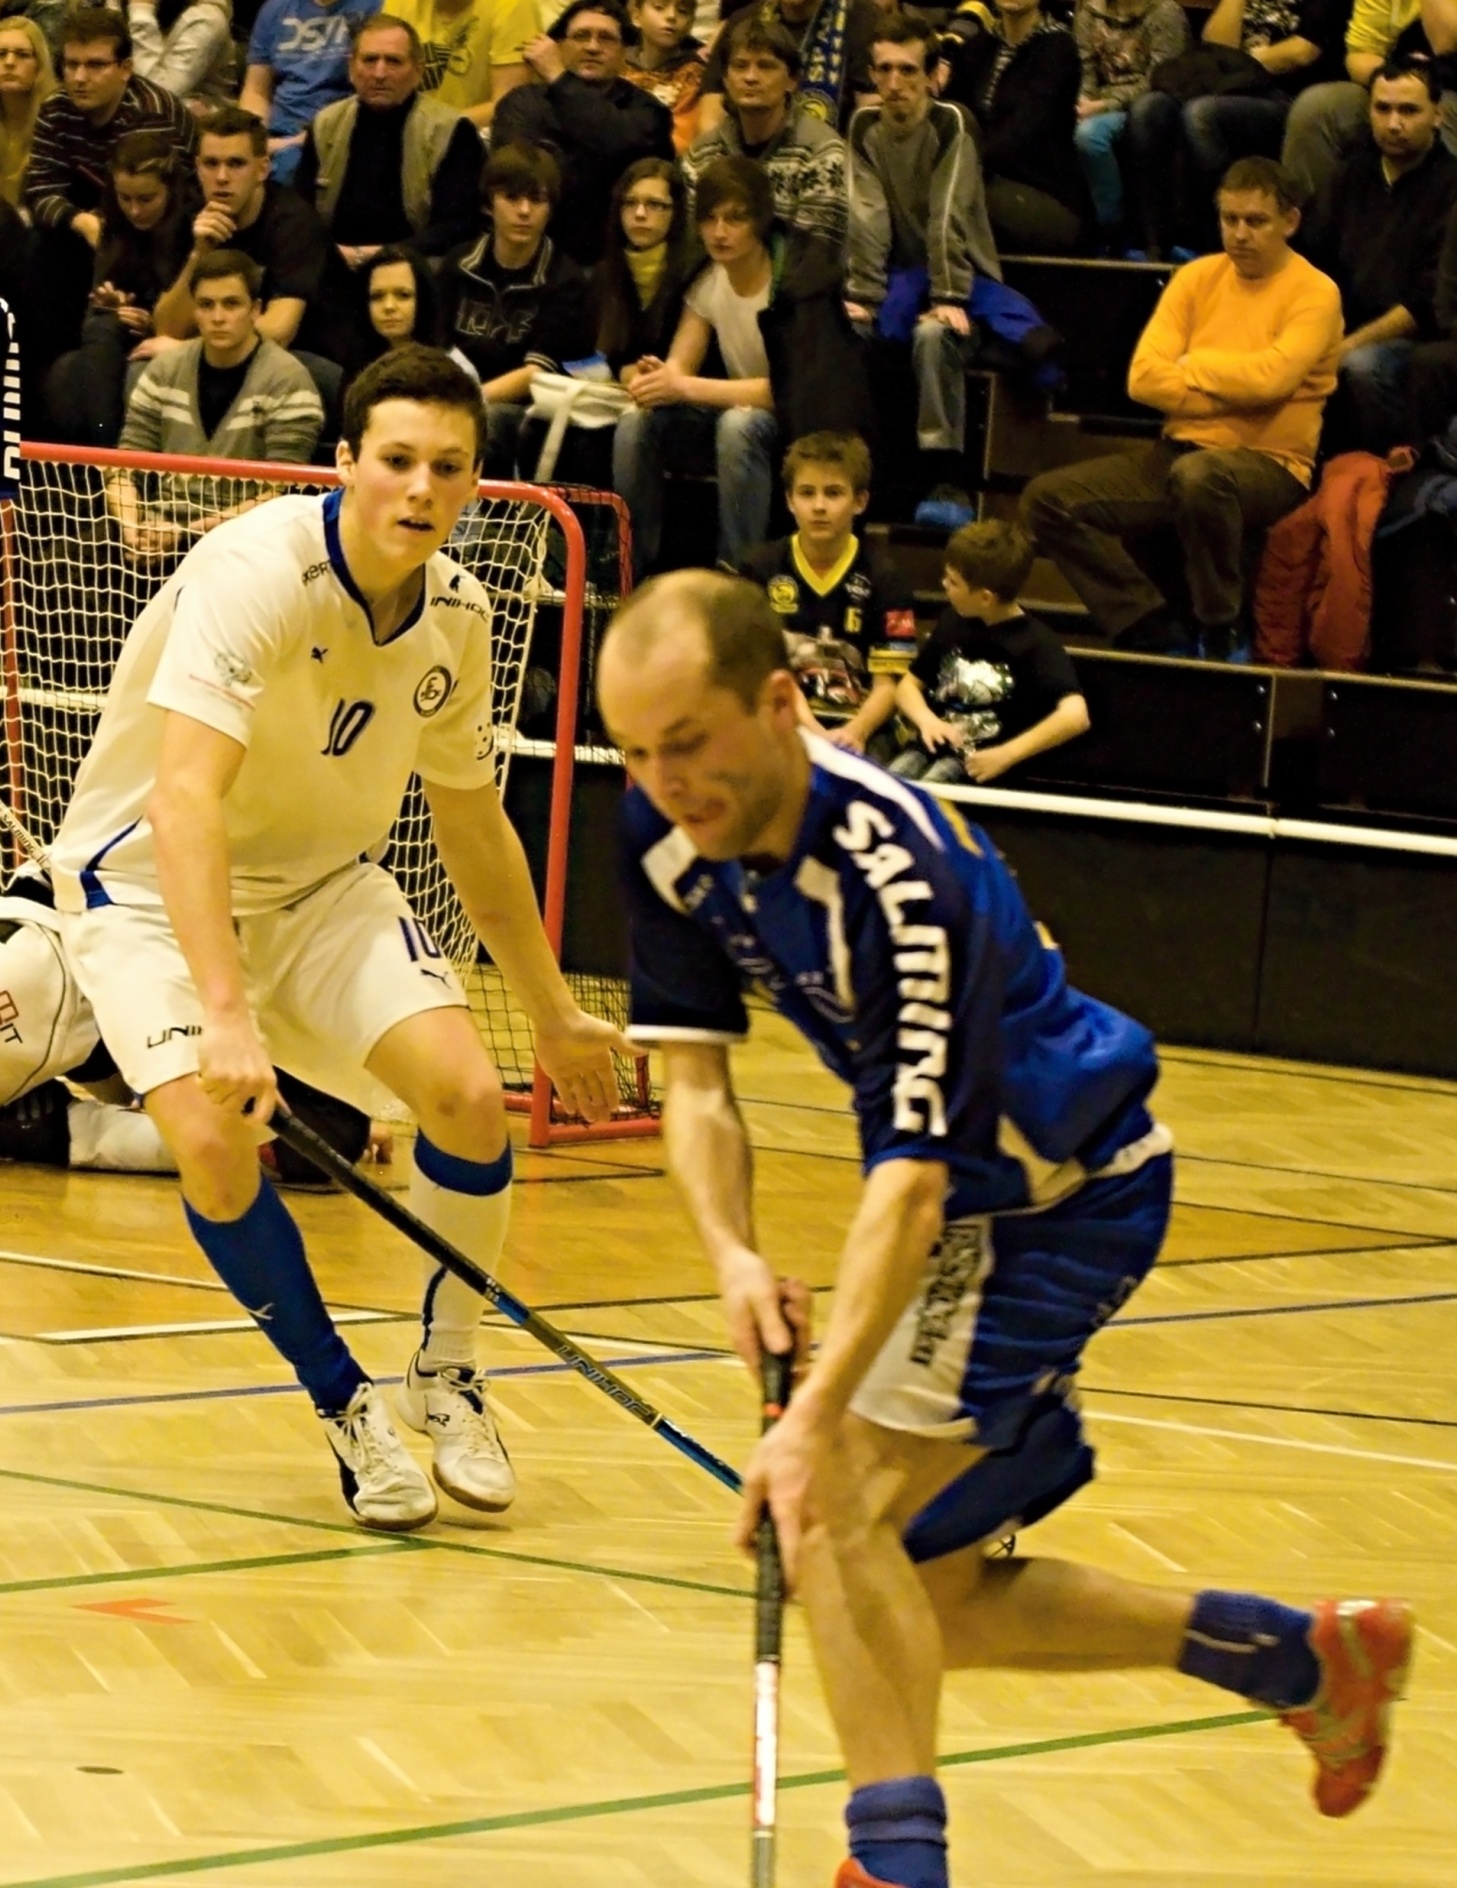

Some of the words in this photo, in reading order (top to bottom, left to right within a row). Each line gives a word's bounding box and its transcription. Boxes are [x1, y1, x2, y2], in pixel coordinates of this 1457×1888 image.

[320, 697, 376, 757] 10
[397, 915, 443, 963] 10
[832, 800, 952, 1137] SALMING
[557, 1345, 652, 1417] UNIHOC
